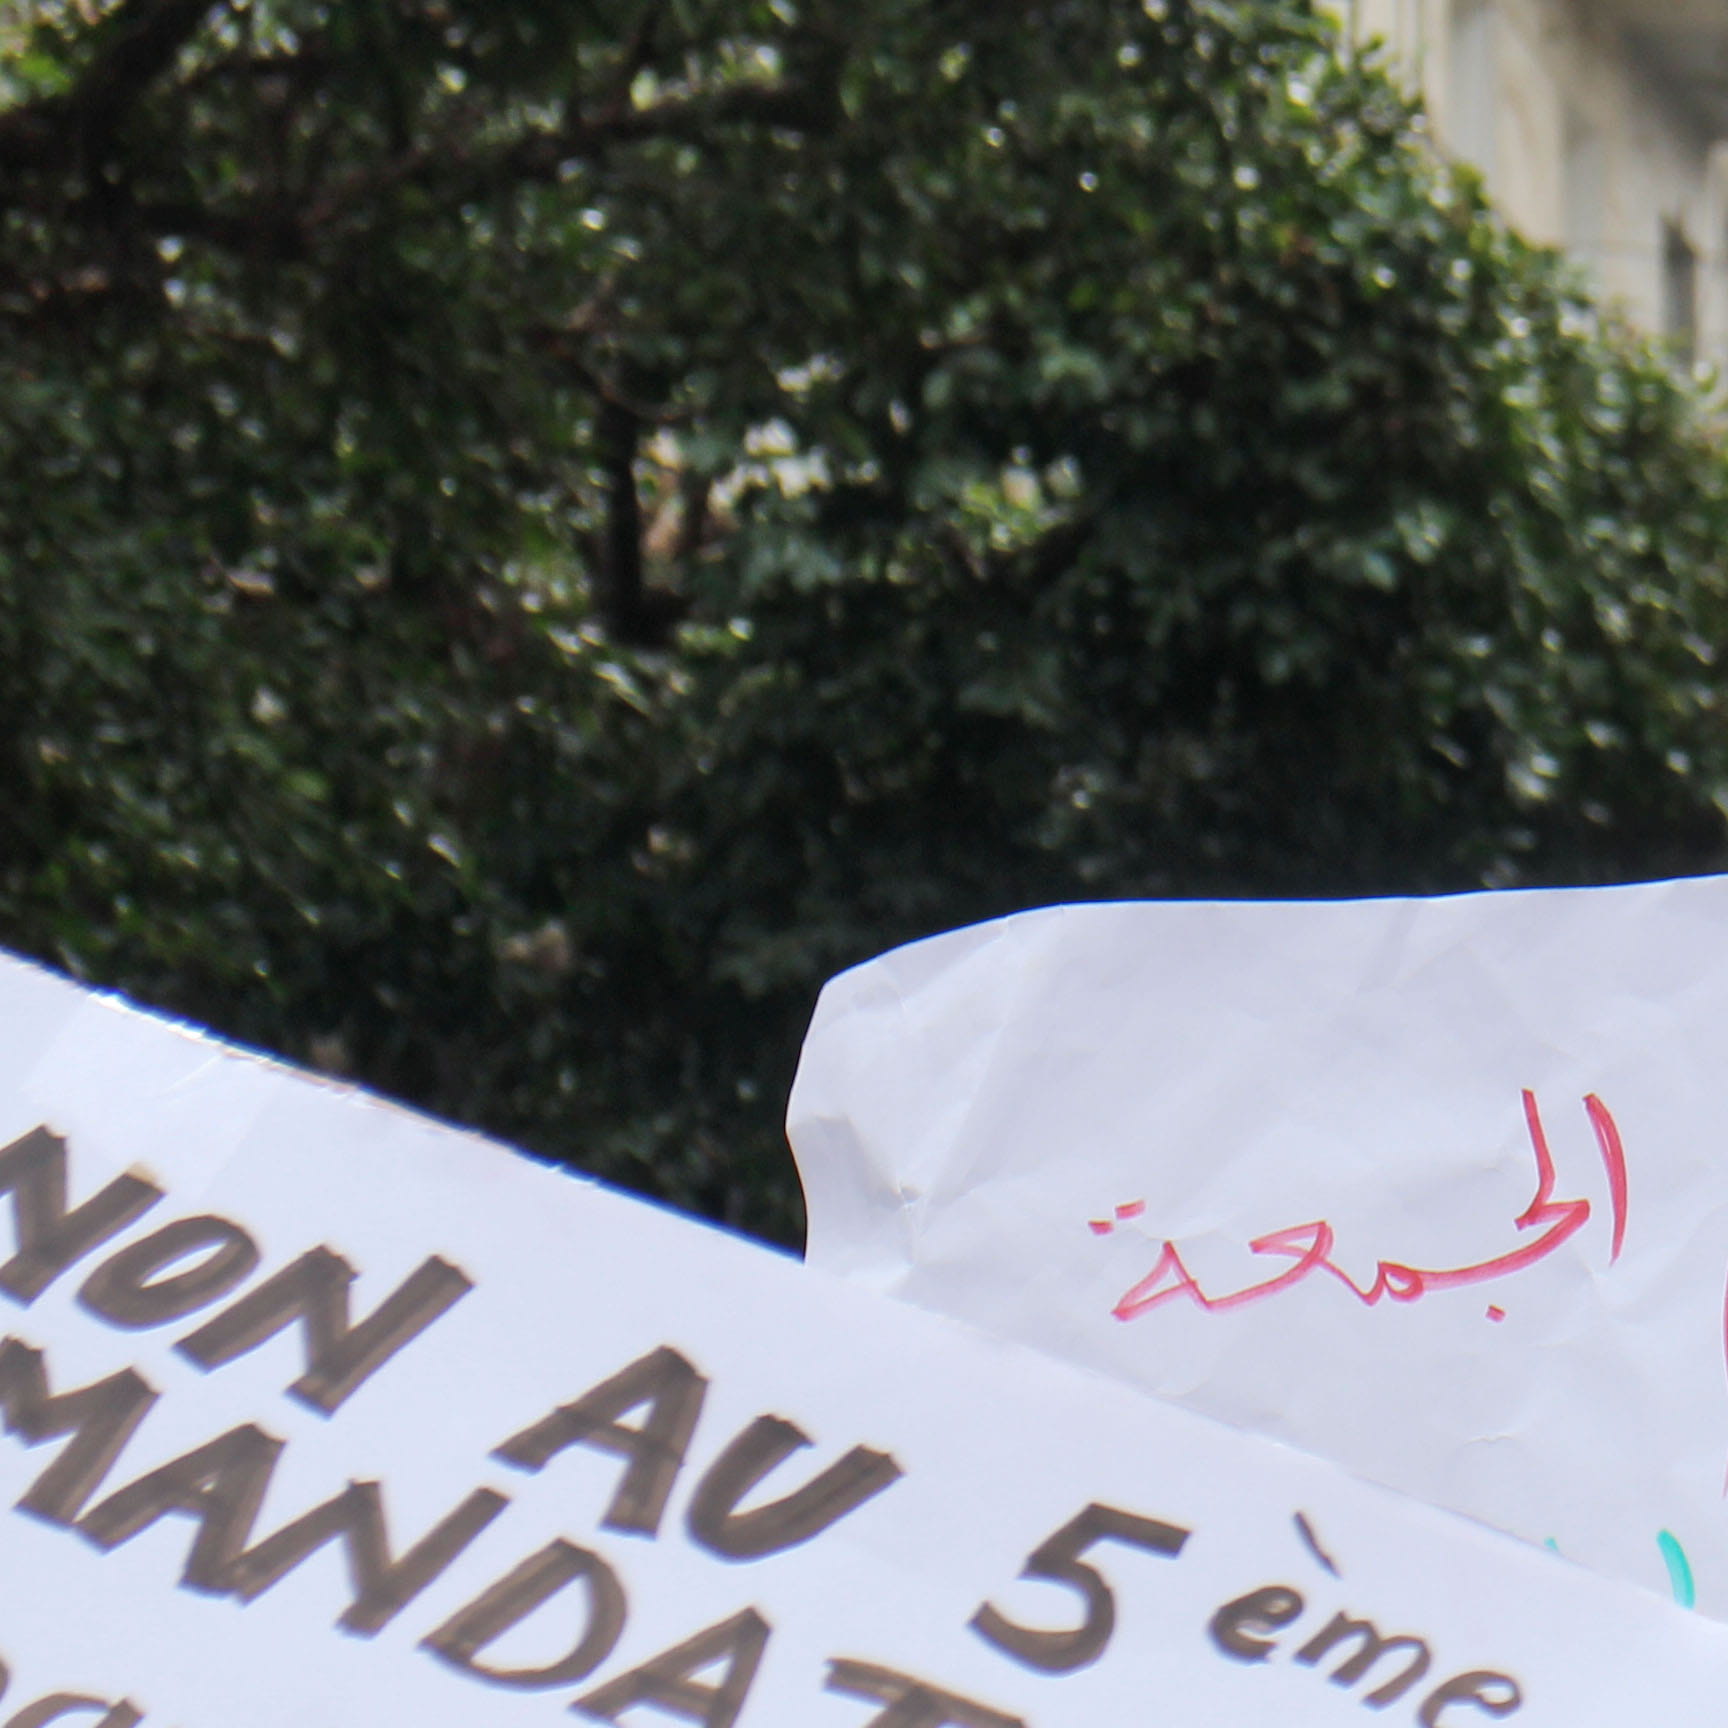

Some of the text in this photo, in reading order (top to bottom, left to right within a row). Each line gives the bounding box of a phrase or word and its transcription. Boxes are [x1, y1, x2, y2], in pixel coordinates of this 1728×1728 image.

[0, 1124, 476, 1421] NON
[487, 1346, 904, 1563] AU
[1088, 1088, 1631, 1324] الجمعة
